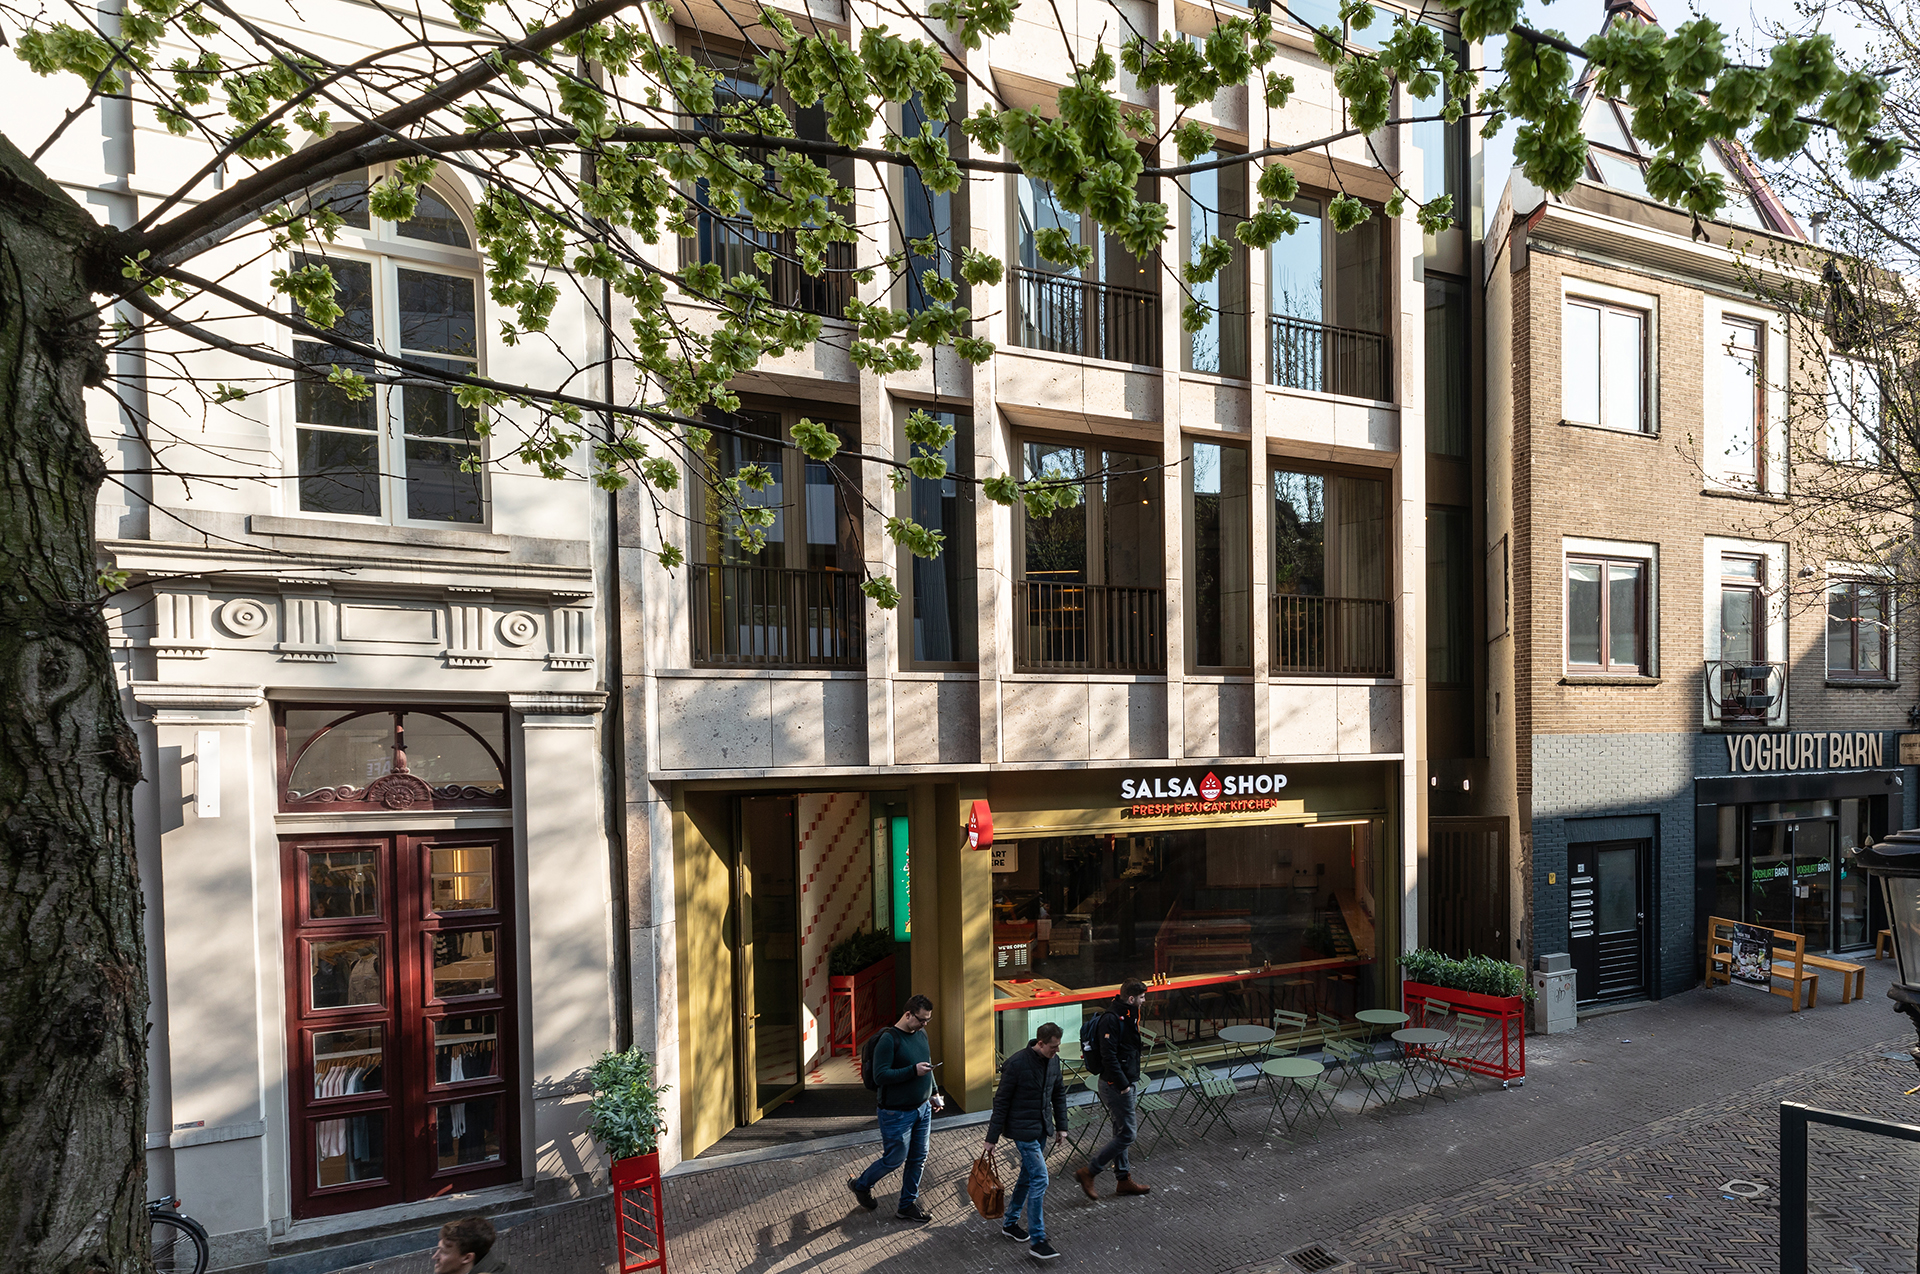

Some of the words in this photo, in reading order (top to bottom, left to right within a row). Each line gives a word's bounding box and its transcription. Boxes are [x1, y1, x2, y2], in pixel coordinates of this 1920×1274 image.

[1726, 732, 1827, 772] YOGHURT
[1829, 732, 1883, 768] BARN
[1121, 777, 1198, 799] SALSA
[1223, 774, 1287, 795] SHOP
[1132, 803, 1170, 815] FRESH
[1173, 800, 1227, 813] MEXICAN
[1230, 798, 1278, 811] KITCHEN
[1752, 867, 1774, 879] YOGHURT
[1774, 867, 1789, 877] BARN
[1796, 863, 1817, 874] YOGHURT
[1817, 862, 1831, 872] BARN
